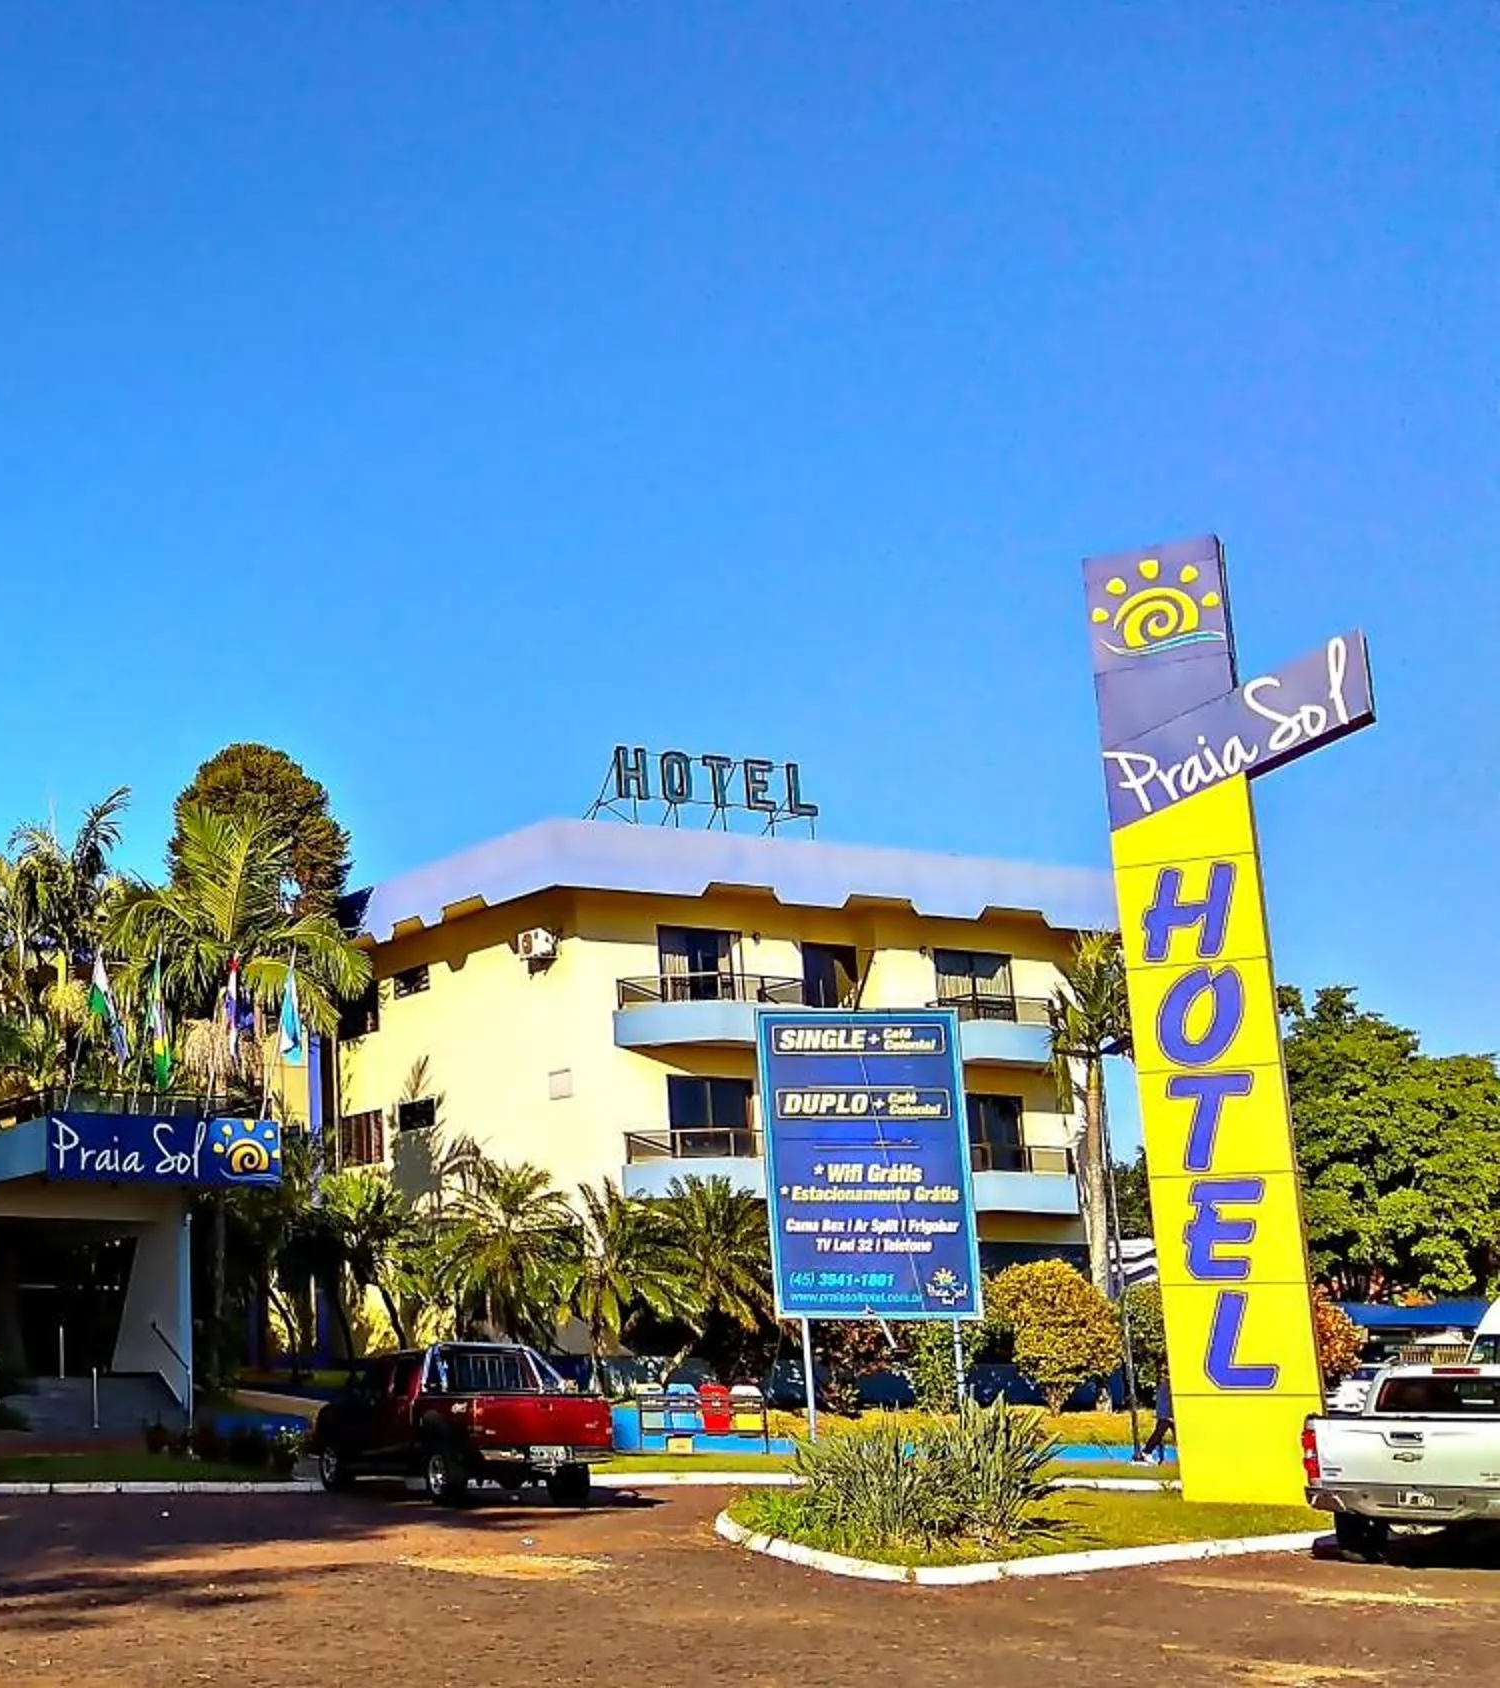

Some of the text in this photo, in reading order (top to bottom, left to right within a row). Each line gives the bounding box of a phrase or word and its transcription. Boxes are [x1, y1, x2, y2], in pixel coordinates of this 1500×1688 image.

[1102, 636, 1350, 813] Praia Sol
[614, 745, 818, 817] HOTEL
[779, 1028, 868, 1050] SINGLE
[883, 1039, 936, 1051] Colonial
[783, 1092, 869, 1115] DUPLO
[888, 1103, 941, 1115] Colonial
[1142, 861, 1279, 1391] HOTEL
[51, 1117, 206, 1178] Praia Sol
[826, 1163, 923, 1183] Wifi Grátis
[791, 1185, 959, 1202] Estacionamento Grátis
[908, 1218, 960, 1235] Frigobar
[815, 1238, 832, 1251] TV
[833, 1238, 856, 1251] Led
[882, 1238, 932, 1252] Telefone
